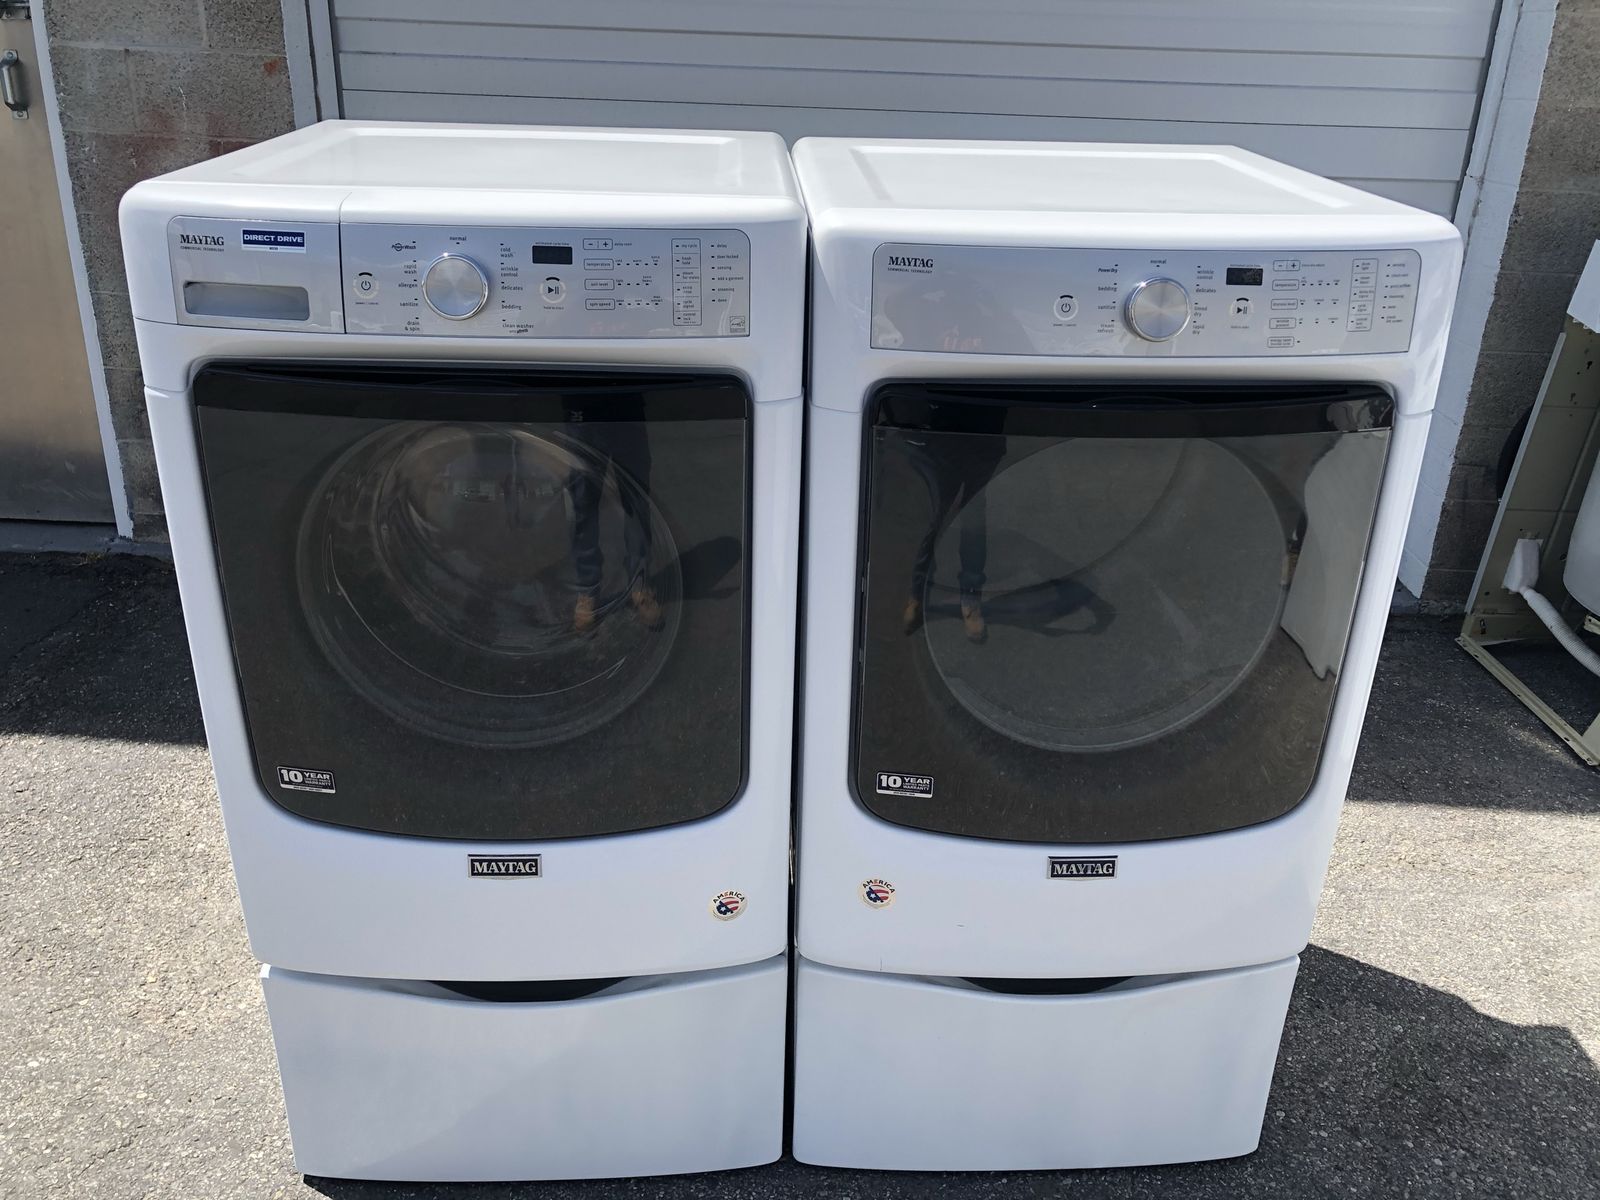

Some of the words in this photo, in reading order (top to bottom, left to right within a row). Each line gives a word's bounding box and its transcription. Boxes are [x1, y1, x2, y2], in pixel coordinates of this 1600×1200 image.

[180, 234, 224, 246] MAYTAG
[888, 256, 934, 268] MAYTAG
[281, 769, 303, 783] 10
[880, 774, 902, 788] 10
[473, 862, 536, 873] MAYTAG
[1053, 863, 1113, 874] MAYTAG
[863, 879, 895, 893] AMERICA
[713, 891, 745, 903] AMERICA
